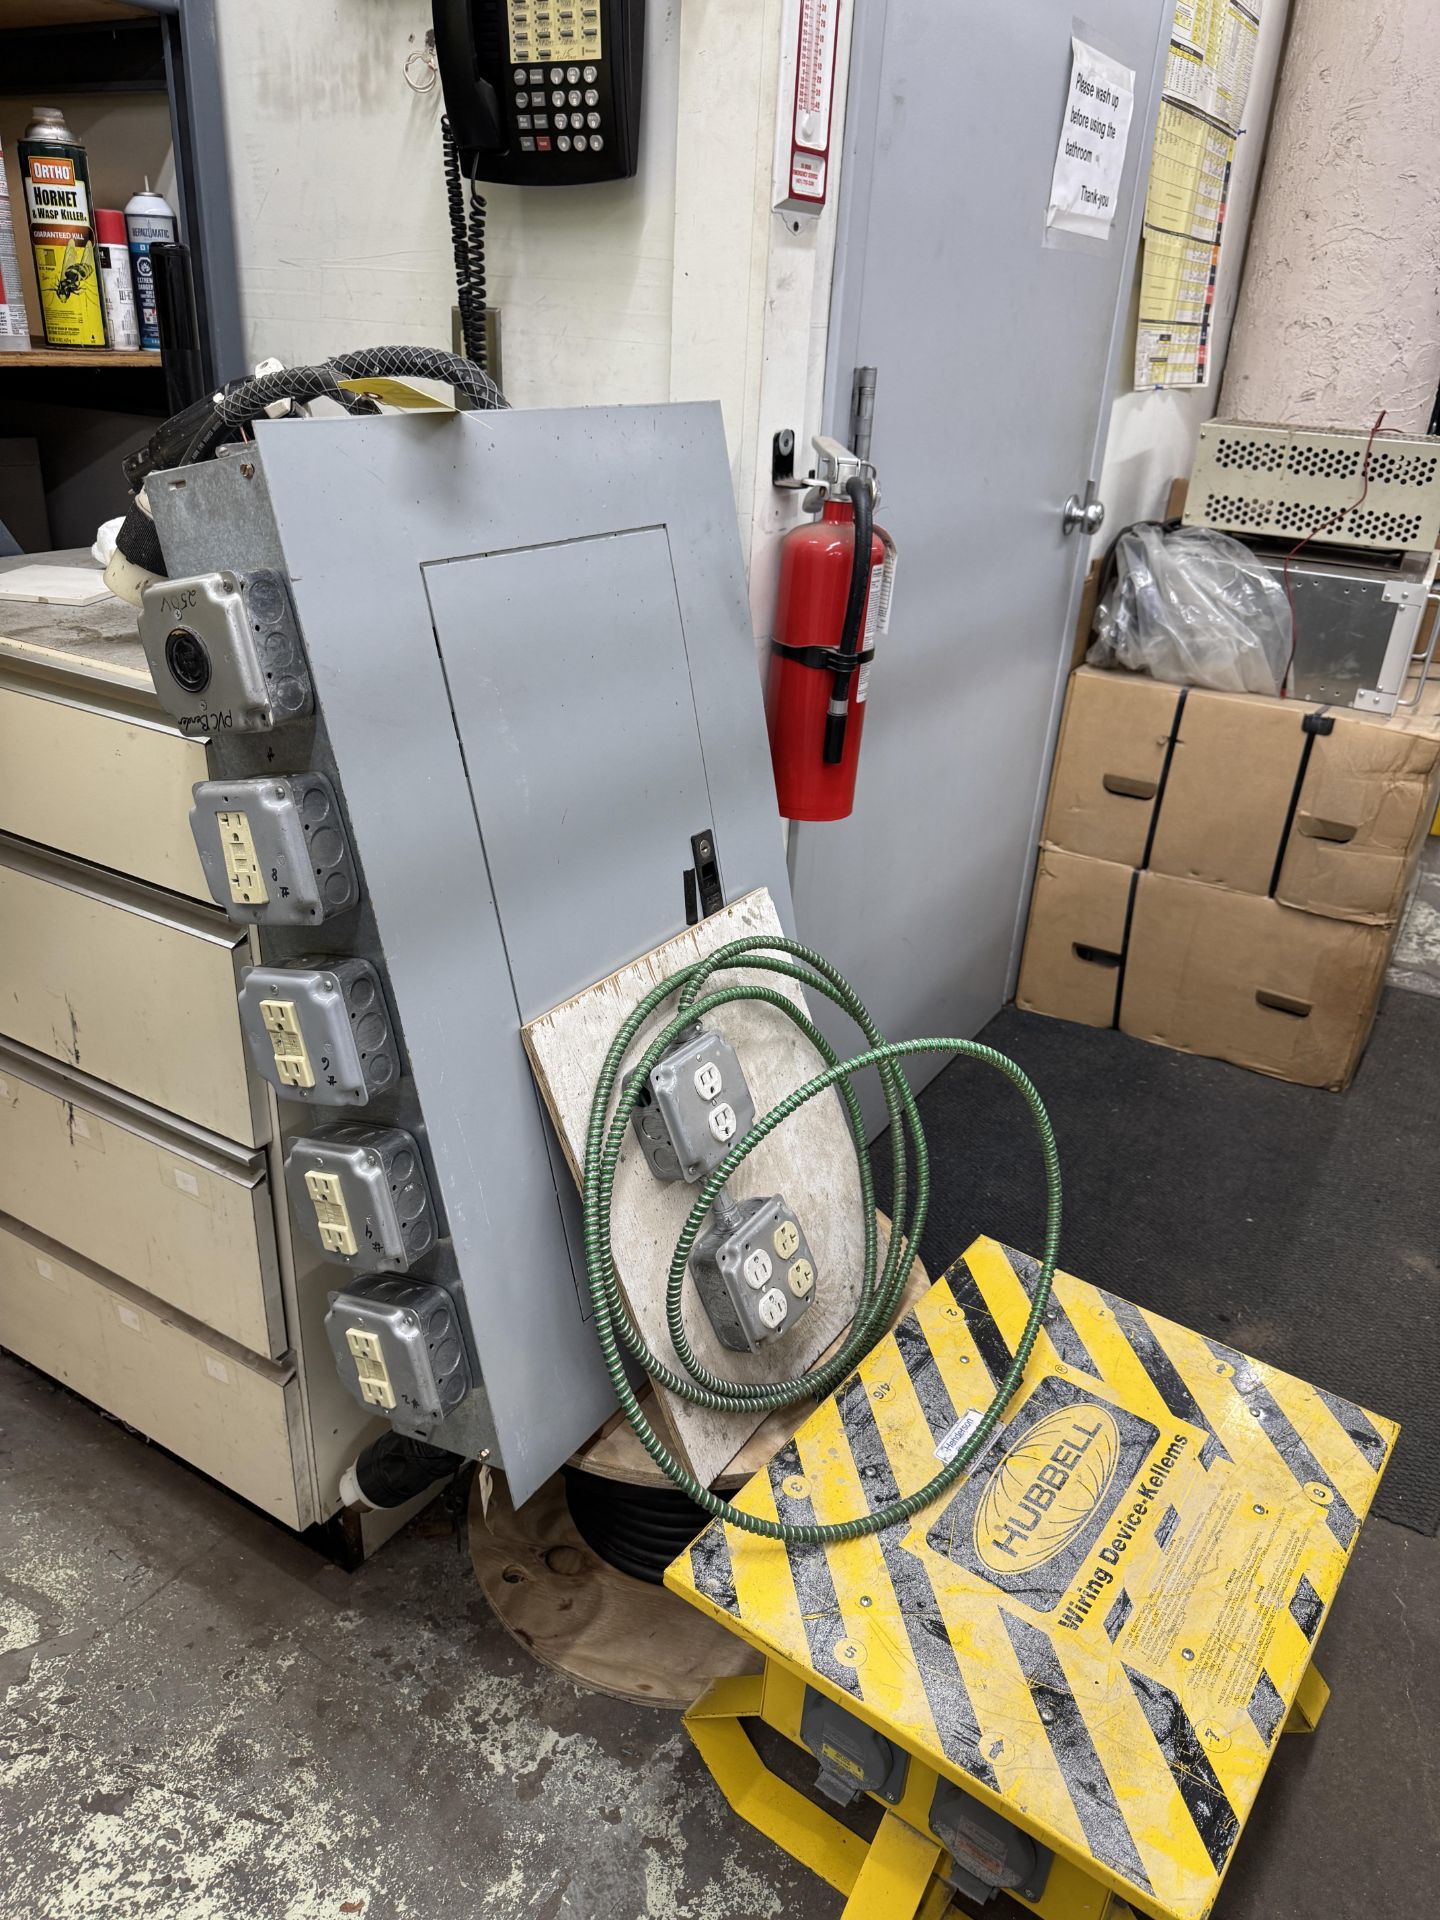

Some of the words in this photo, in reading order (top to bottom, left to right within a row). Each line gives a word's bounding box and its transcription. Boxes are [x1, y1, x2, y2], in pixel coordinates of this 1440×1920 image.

[1075, 72, 1095, 98] Please
[1095, 86, 1111, 105] wash
[1111, 94, 1119, 112] up
[1070, 105, 1089, 128] before
[1090, 116, 1107, 139] using
[1107, 122, 1116, 139] the
[1065, 138, 1093, 163] bathroom
[33, 162, 70, 180] ORTHO
[33, 186, 77, 208] HORNET
[31, 211, 37, 219] &
[37, 207, 59, 220] WASP
[33, 230, 71, 240] GUARANTEED
[72, 232, 85, 241] KILL
[210, 709, 233, 731] PVC
[946, 1308, 958, 1317] 2
[943, 1417, 974, 1453] Henderson
[790, 1481, 803, 1492] 3
[991, 1422, 1103, 1558] HUBBELL
[1312, 1488, 1326, 1498] 8
[1057, 1566, 1114, 1631] Wiring
[1098, 1434, 1189, 1566] Device-Kellems
[843, 1645, 858, 1659] 5
[1204, 1728, 1221, 1742] 7
